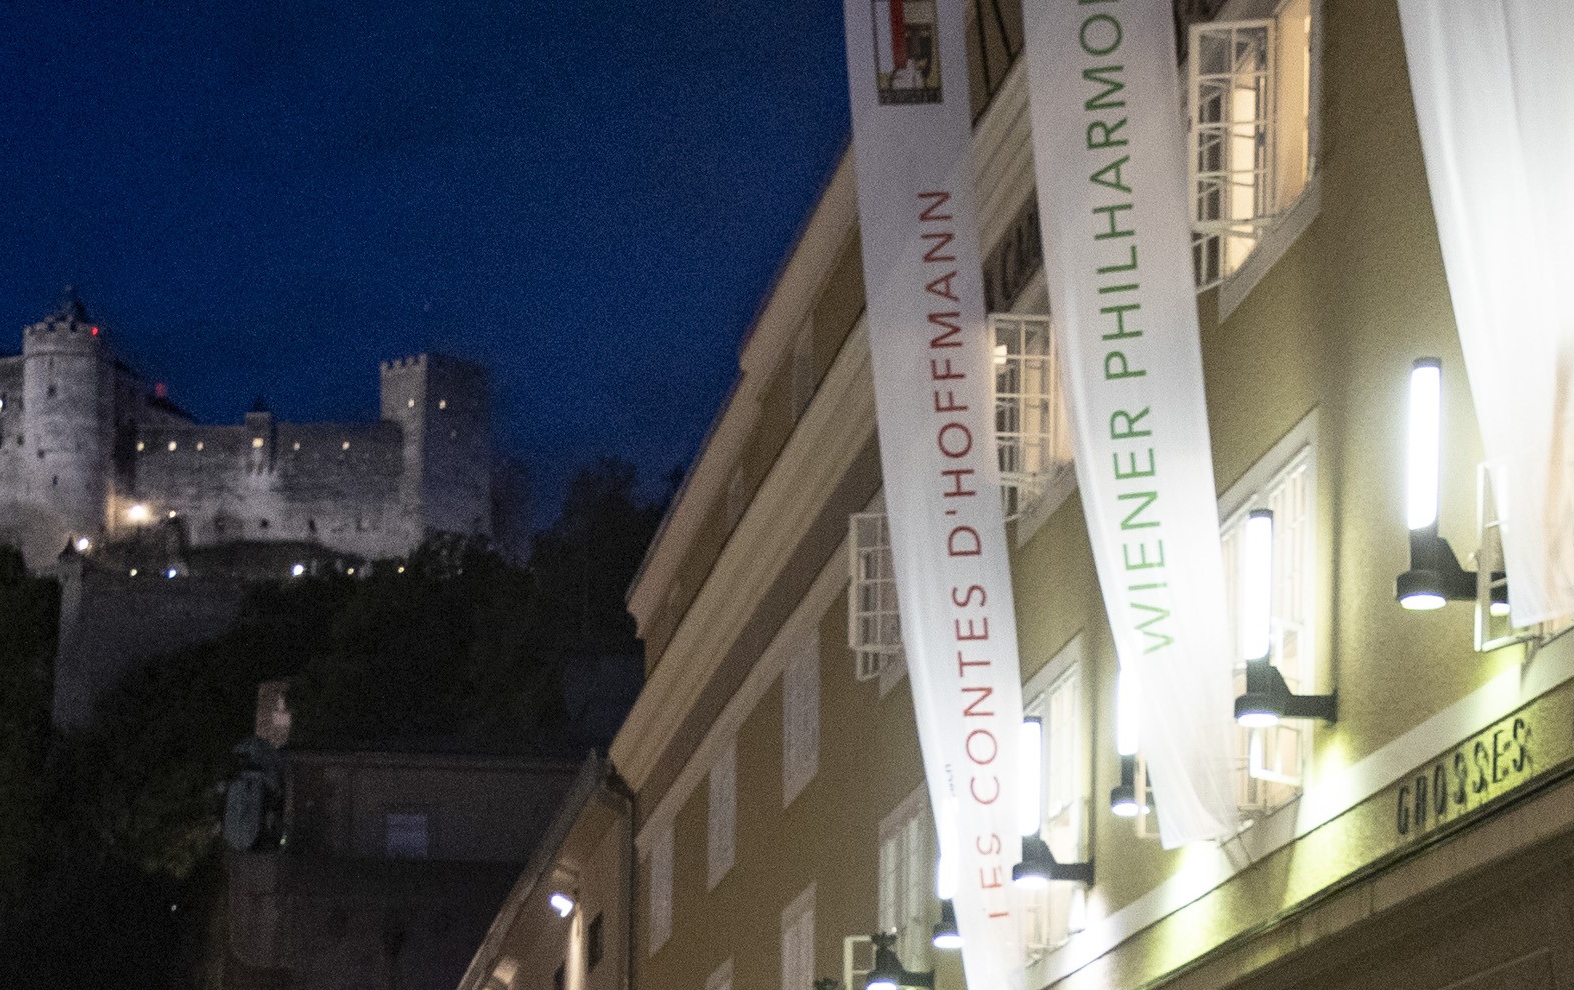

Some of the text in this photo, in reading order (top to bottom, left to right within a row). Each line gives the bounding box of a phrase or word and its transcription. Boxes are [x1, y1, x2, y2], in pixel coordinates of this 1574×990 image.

[917, 190, 982, 557] D'HOFFMANN
[1078, 0, 1175, 655] WIENER PHILHARMO
[952, 584, 1000, 805] CONTES
[1397, 717, 1526, 836] GROSSES
